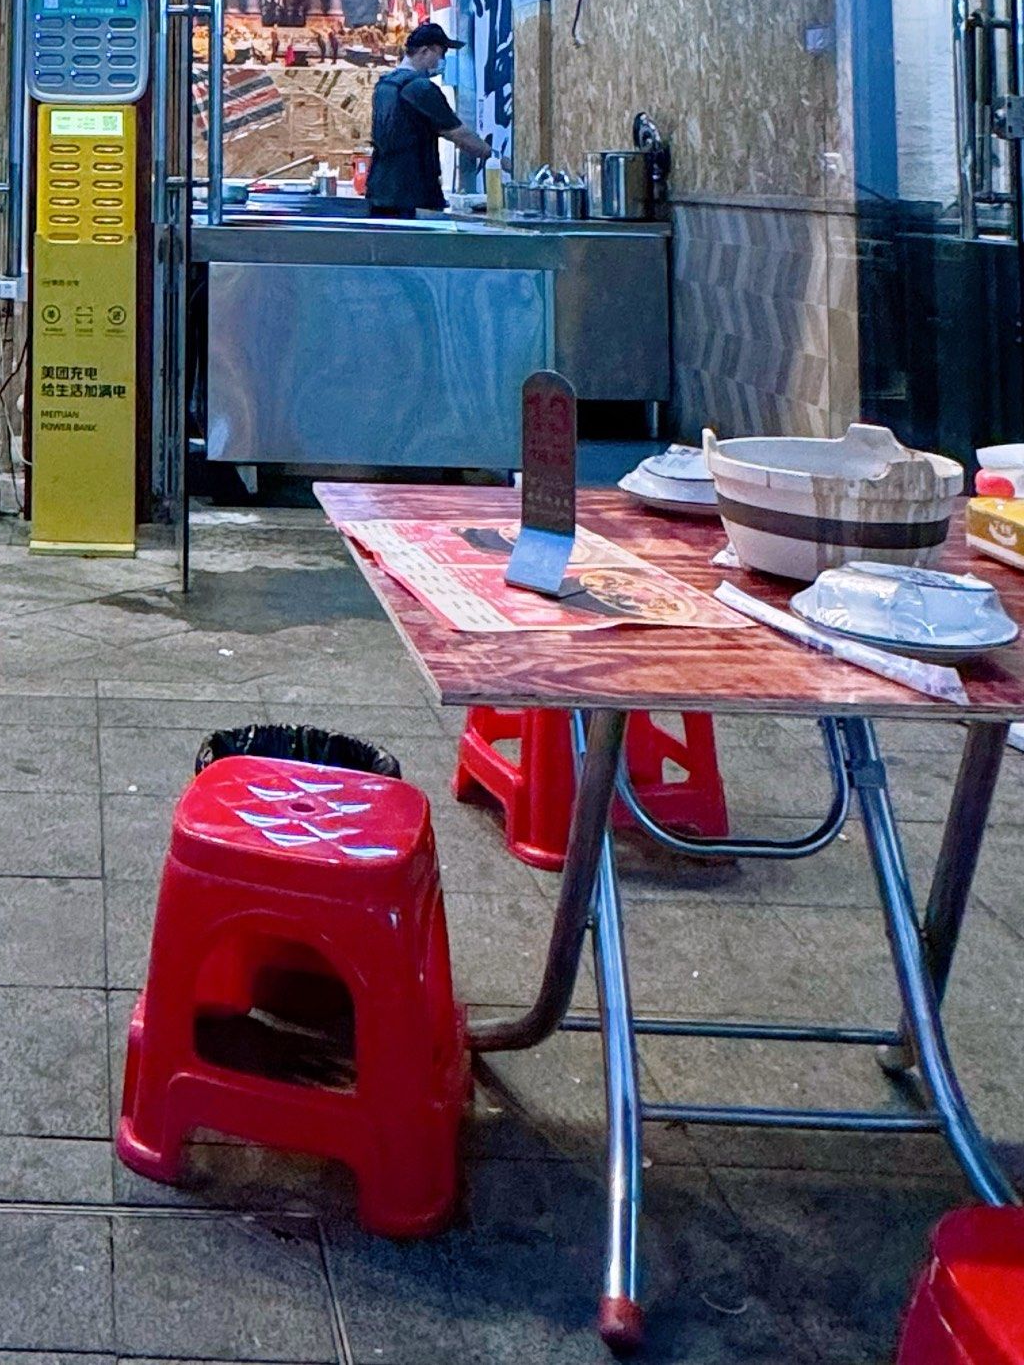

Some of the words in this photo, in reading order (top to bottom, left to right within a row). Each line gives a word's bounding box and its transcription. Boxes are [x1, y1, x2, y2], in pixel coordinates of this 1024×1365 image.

[41, 366, 97, 380] 美团充电
[41, 383, 126, 399] 给生活加满电
